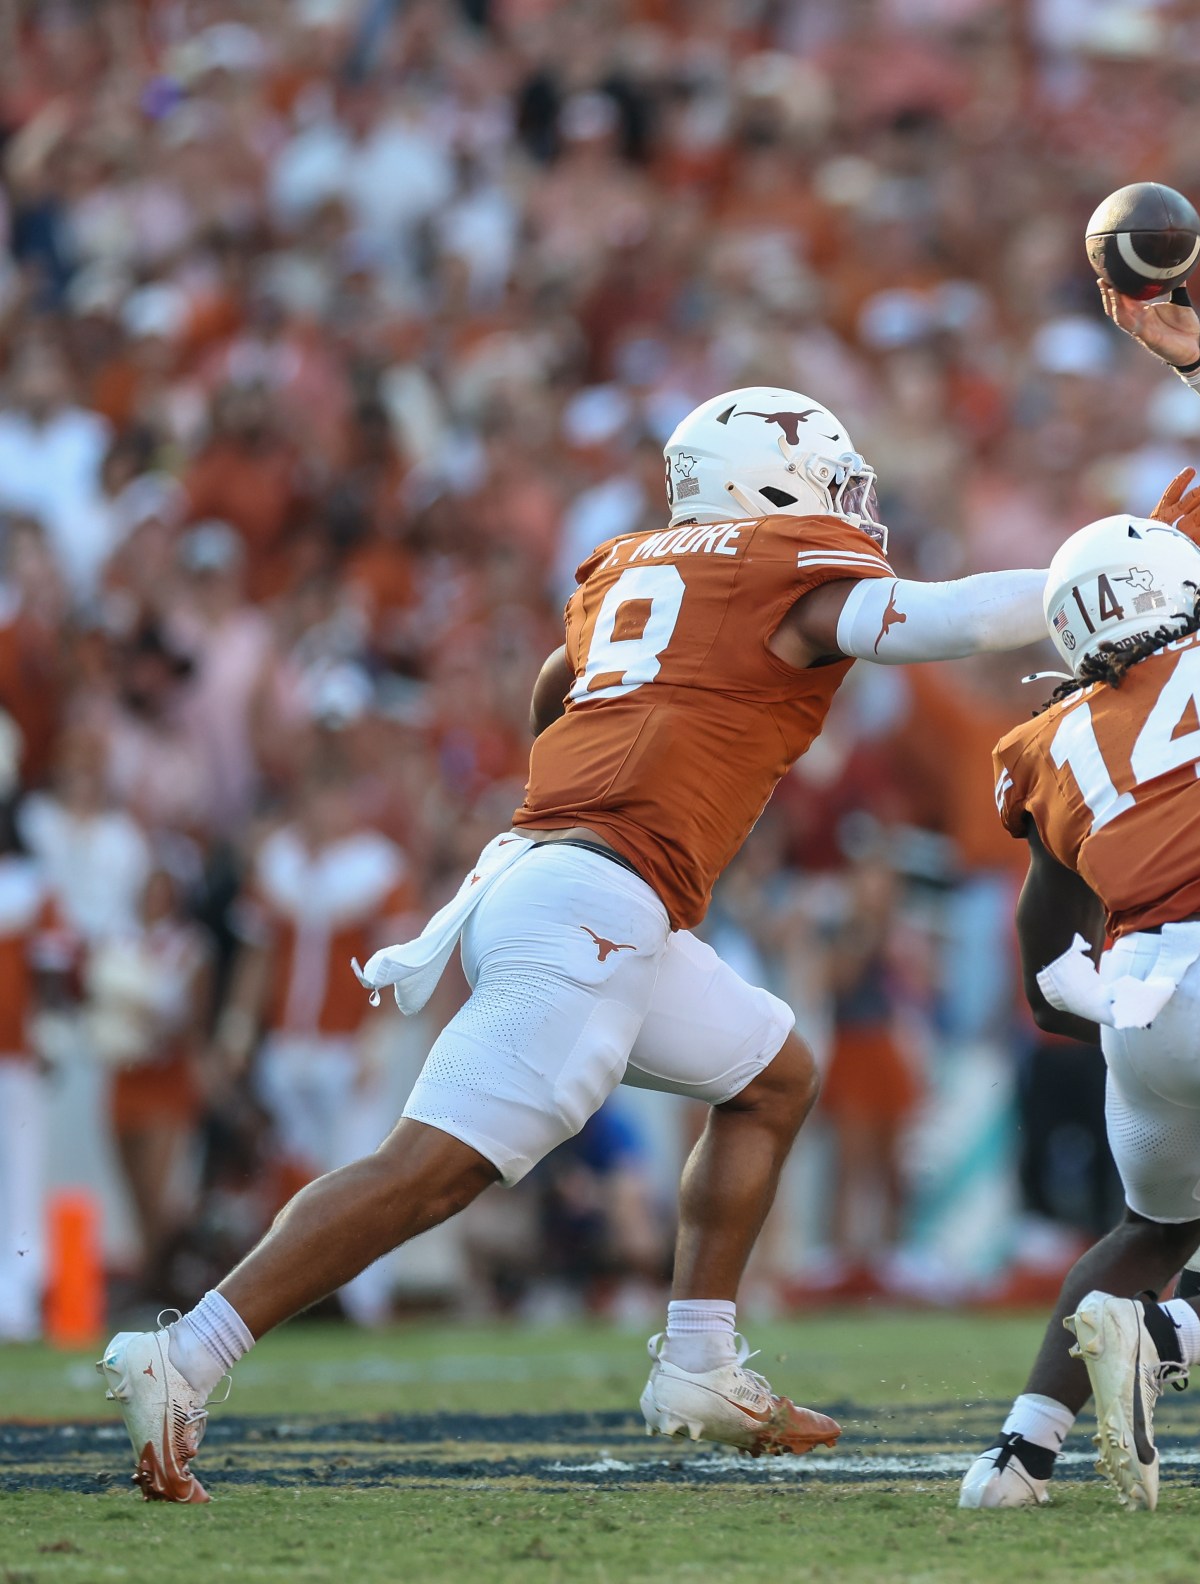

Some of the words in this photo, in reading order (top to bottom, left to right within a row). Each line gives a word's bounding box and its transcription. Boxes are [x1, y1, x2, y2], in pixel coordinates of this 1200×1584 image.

[628, 521, 758, 562] MOORE
[569, 564, 686, 703] 8
[1072, 574, 1124, 634] 14
